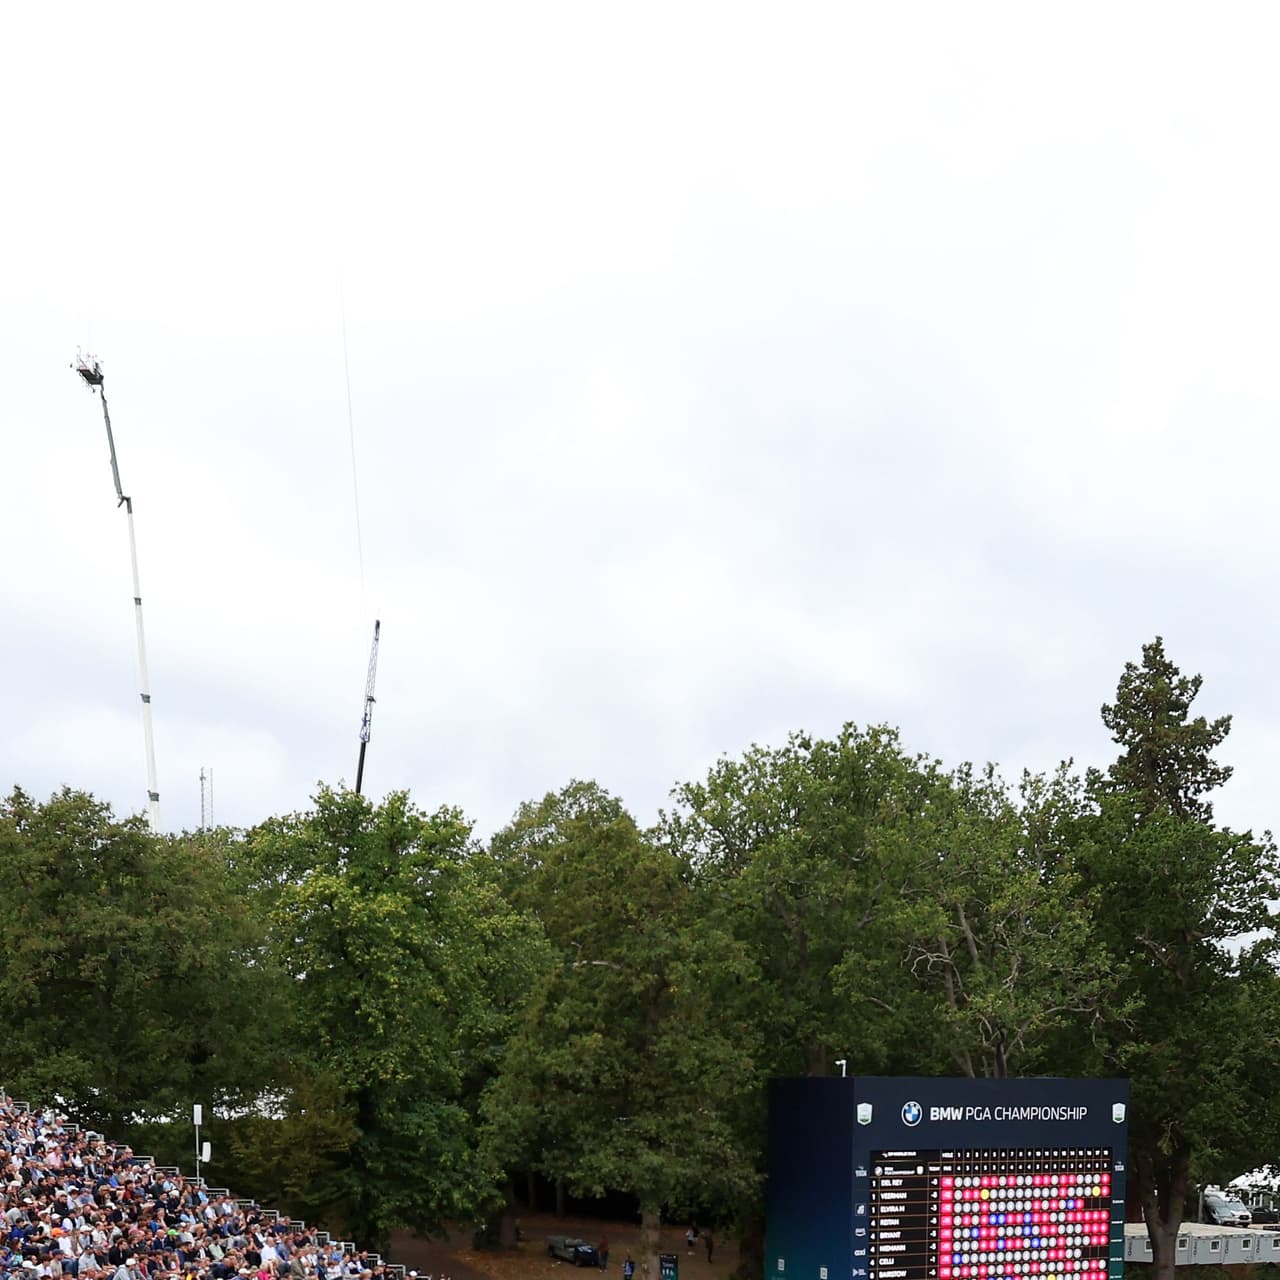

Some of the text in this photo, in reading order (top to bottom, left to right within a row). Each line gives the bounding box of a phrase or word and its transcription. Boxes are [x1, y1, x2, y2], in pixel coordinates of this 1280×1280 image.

[930, 1106, 1088, 1121] BMW PGA CHAMPIONSHIP
[880, 1179, 892, 1187] DEL
[892, 1178, 903, 1186] REY
[880, 1192, 908, 1200] VEERMAN
[880, 1206, 900, 1214] ELVIRA
[880, 1232, 902, 1240] BRYANT
